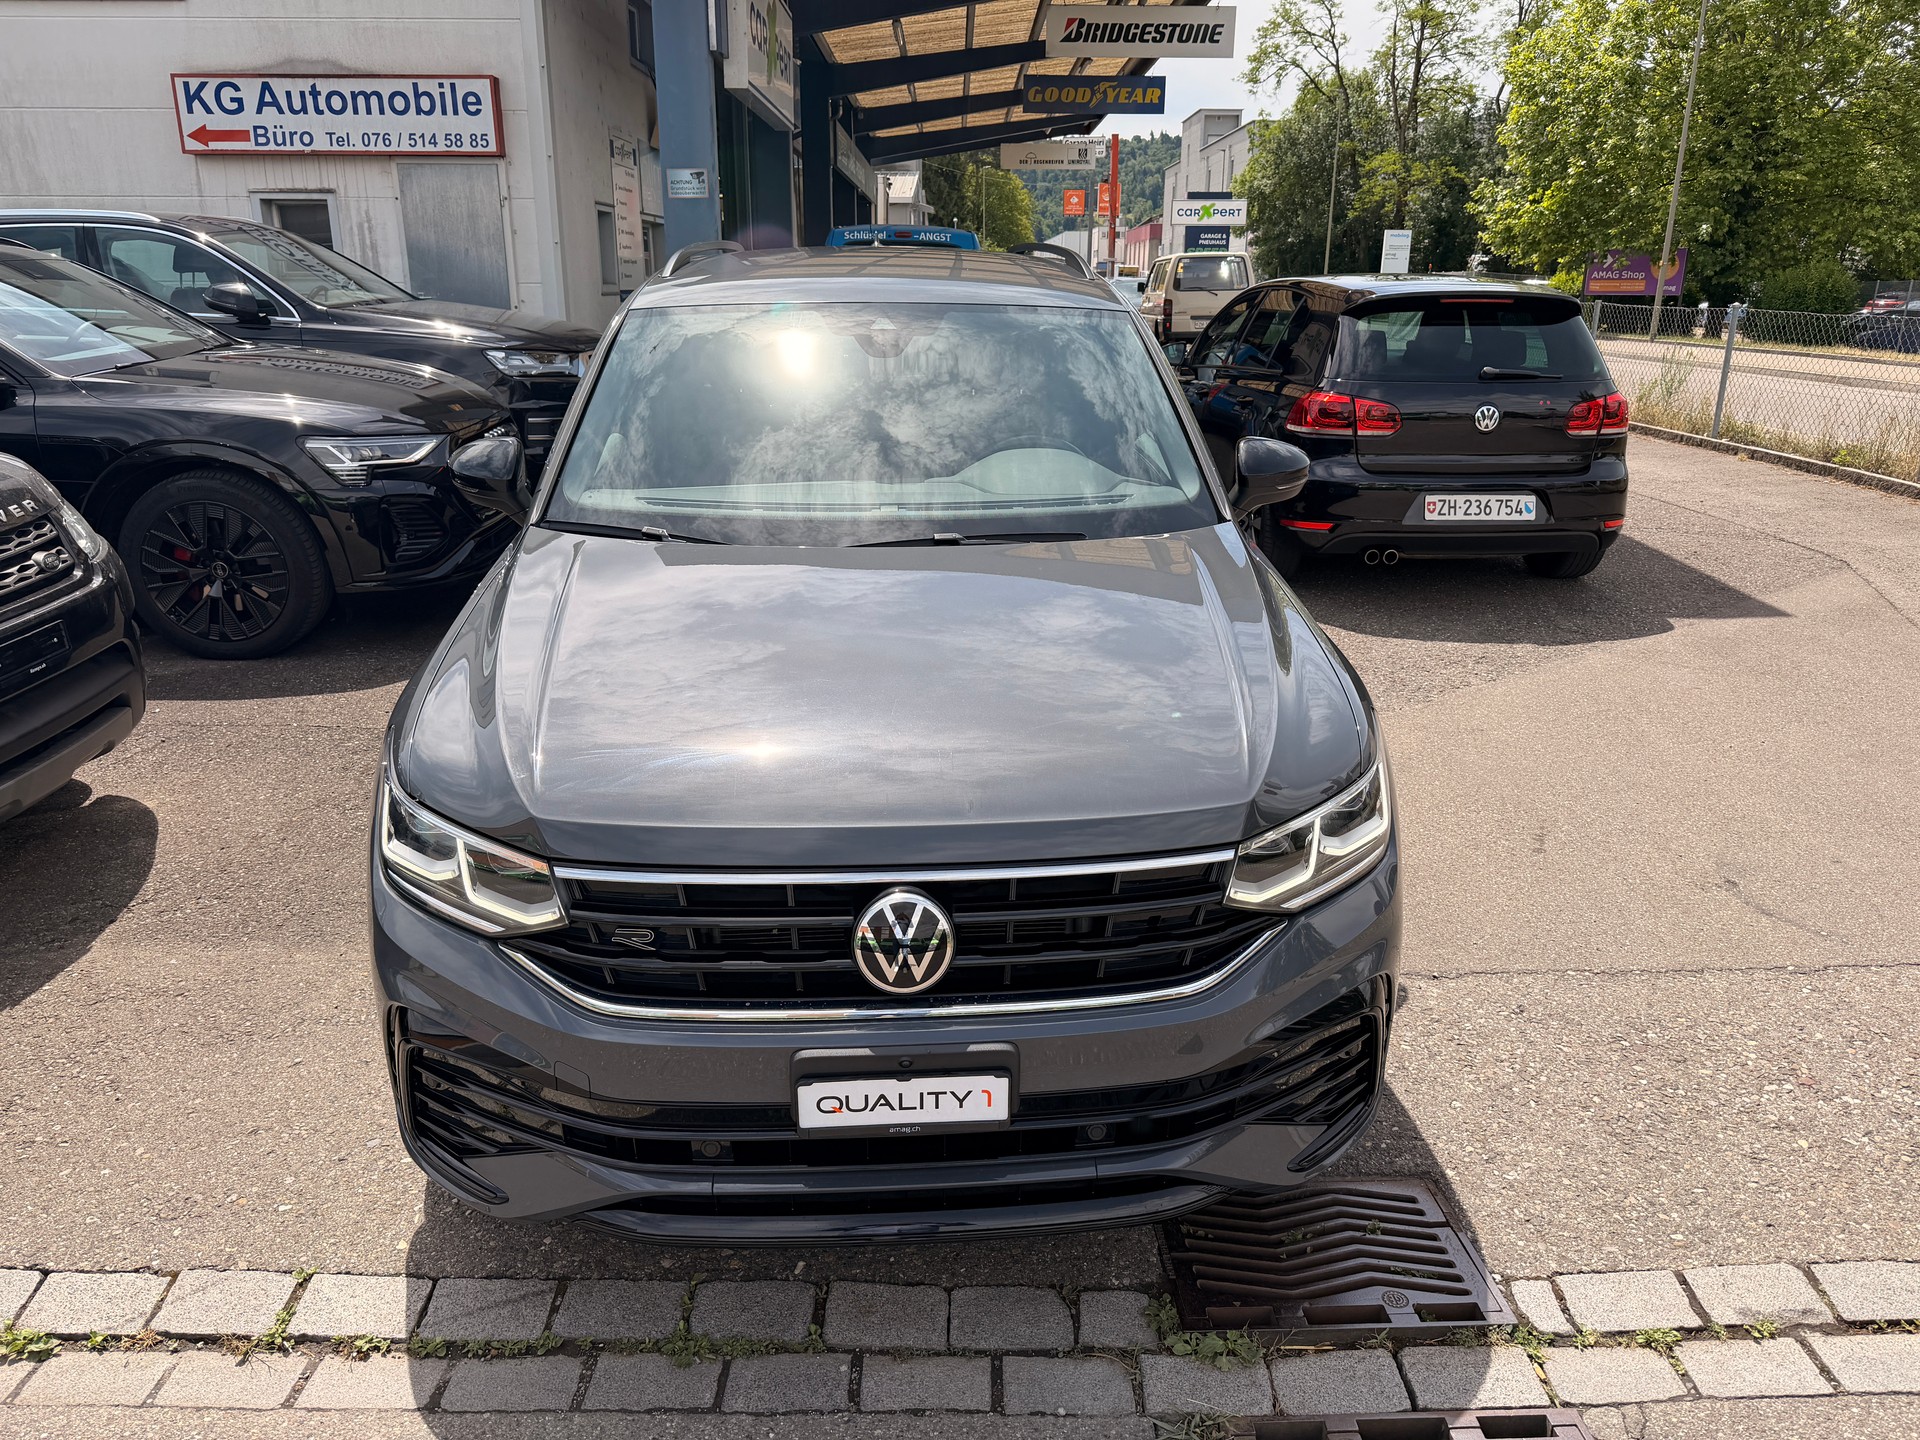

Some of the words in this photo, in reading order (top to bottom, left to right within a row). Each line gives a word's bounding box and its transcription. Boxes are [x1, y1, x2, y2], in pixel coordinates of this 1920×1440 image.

[1060, 17, 1225, 44] BRIDGESTONE
[182, 80, 245, 115] KG
[255, 81, 482, 116] Automobile
[252, 124, 314, 147] Büro
[325, 131, 356, 147] Tel.
[361, 132, 392, 147] 076
[397, 132, 402, 147] /
[408, 132, 438, 148] 514
[444, 133, 463, 148] 58
[469, 133, 489, 148] 85
[1591, 270, 1619, 279] AMAG
[1621, 270, 1646, 280] Shop
[1663, 284, 1677, 292] mag
[816, 1090, 973, 1114] QUALITY
[981, 1089, 992, 1107] 1
[889, 1125, 921, 1133] amag.ch
